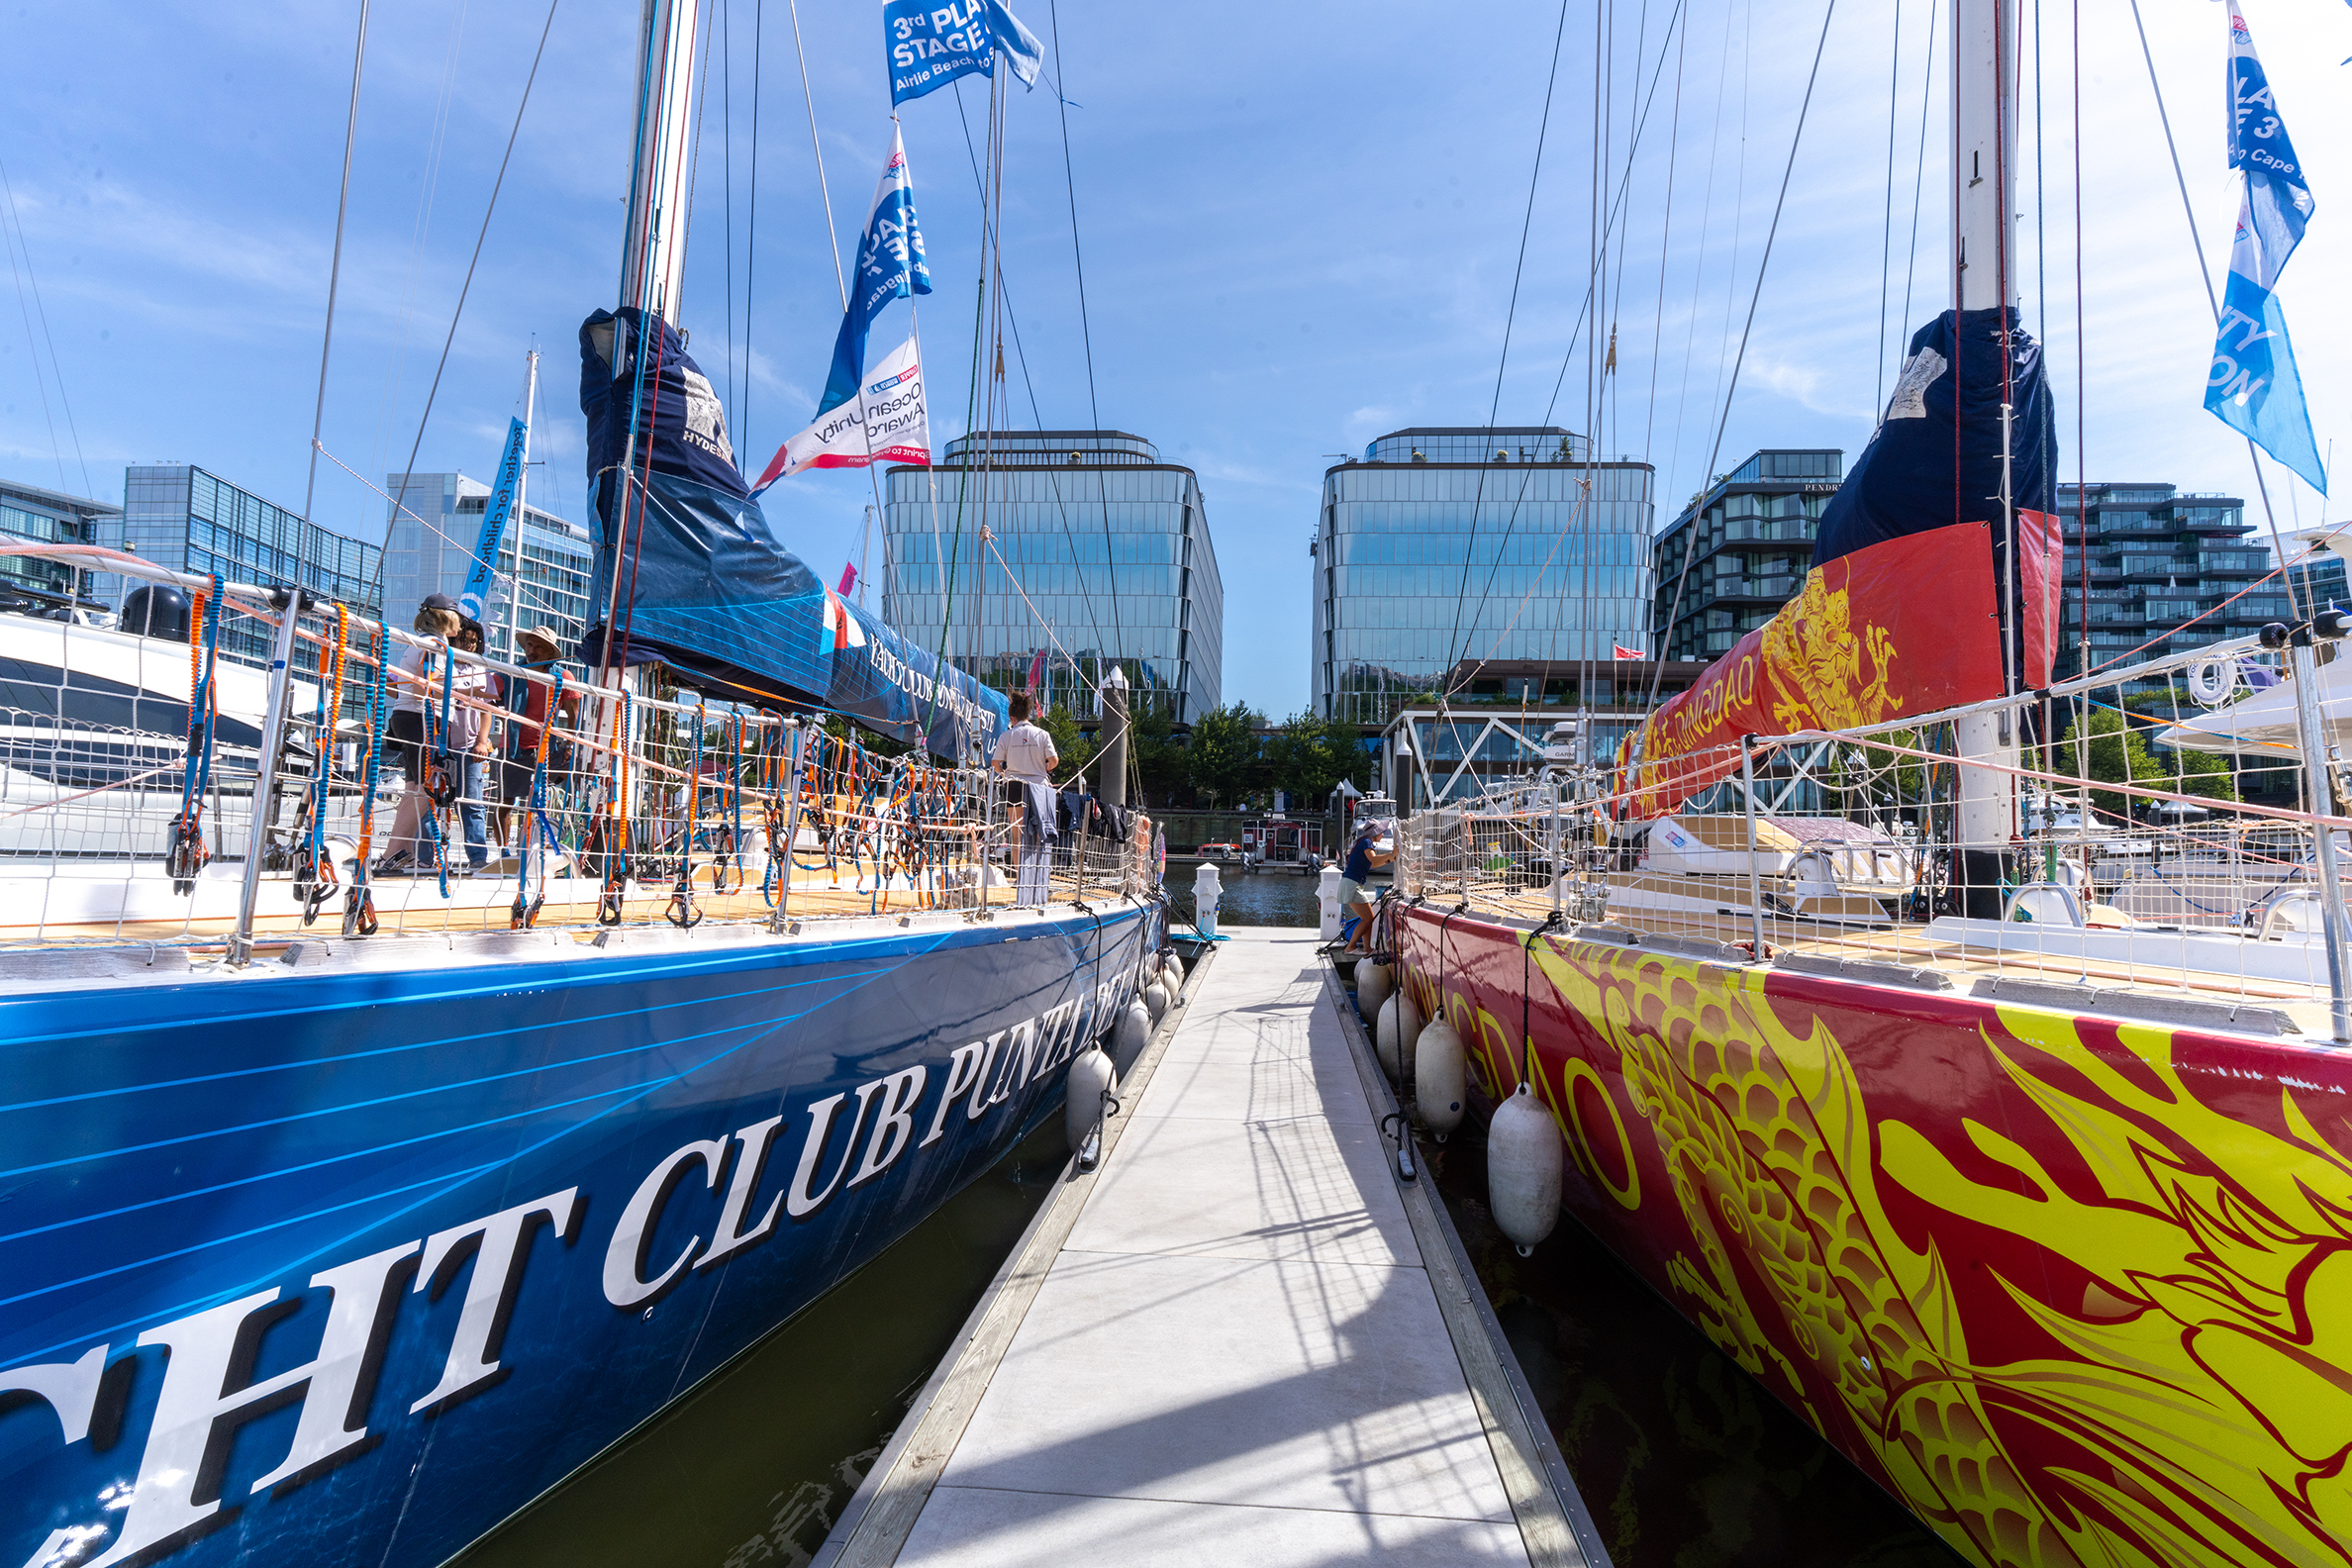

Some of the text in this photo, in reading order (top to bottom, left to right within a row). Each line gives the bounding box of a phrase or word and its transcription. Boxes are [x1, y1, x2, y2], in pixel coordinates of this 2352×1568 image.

[893, 13, 926, 40] 3rd
[893, 21, 985, 67] STAGE
[896, 55, 990, 92] Airlie Beach to
[2250, 148, 2296, 173] Cape
[870, 633, 908, 687] YACHT
[902, 664, 934, 703] CLUB
[1674, 654, 1754, 751] QINGDAO
[602, 1063, 928, 1307] CLUB
[918, 992, 1086, 1149] PUNTA
